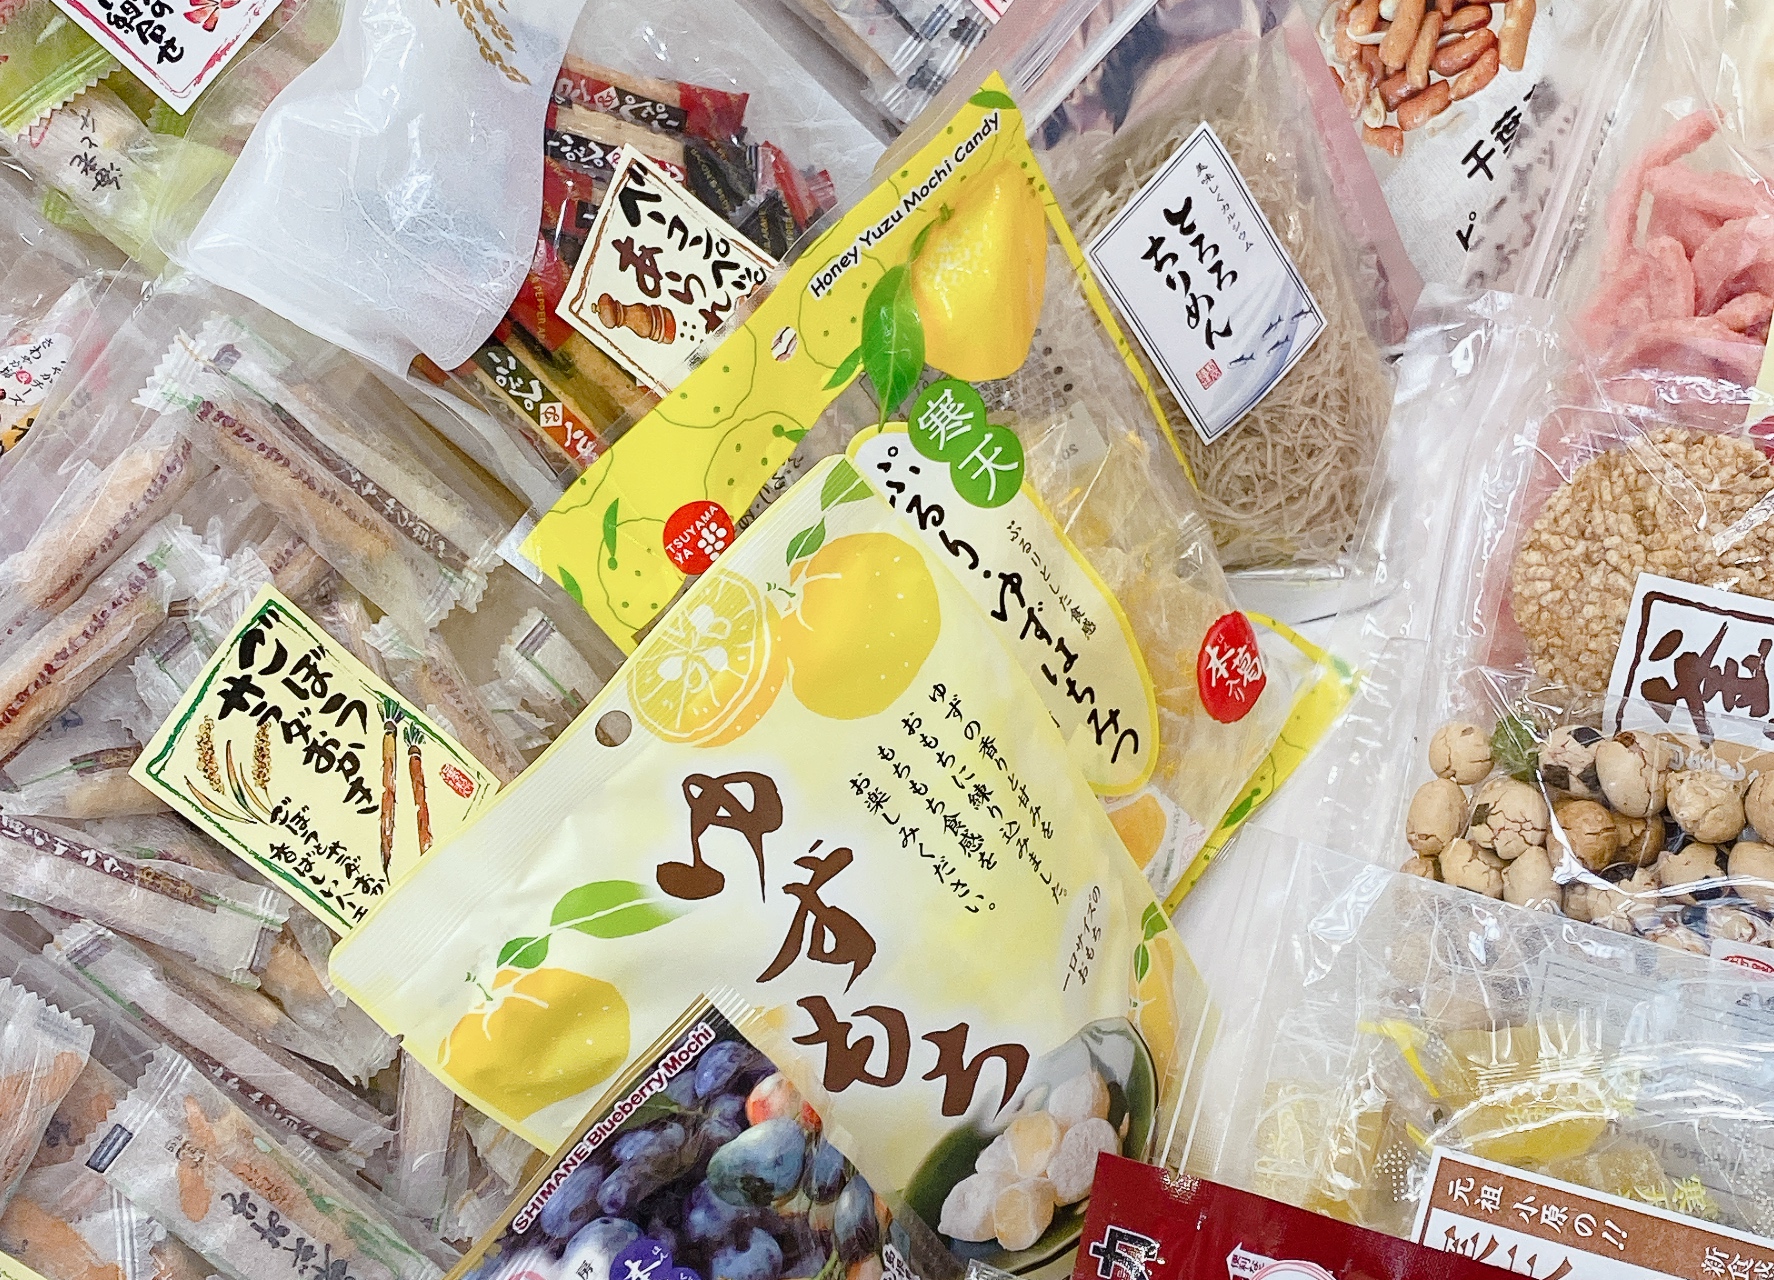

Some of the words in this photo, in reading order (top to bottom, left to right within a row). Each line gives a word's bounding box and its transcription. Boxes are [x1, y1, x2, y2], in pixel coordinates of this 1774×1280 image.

[811, 246, 861, 298] Honey
[860, 213, 903, 253] Yuzu
[904, 164, 951, 211] Mochi
[953, 112, 1003, 164] Candy
[1164, 196, 1238, 290] とろろ
[1195, 162, 1254, 253] 美味しくカルシウム
[612, 235, 732, 335] あられ
[1141, 235, 1233, 351] ちりめん
[918, 388, 1019, 502] 寒天
[664, 502, 720, 555] TSUYAMA
[674, 546, 695, 567] YA
[238, 608, 370, 736] ごぼう
[217, 673, 380, 815] サラダおかき
[928, 682, 1054, 840] ゆずの香りと甘みを
[848, 772, 996, 915] お楽しみください。
[876, 744, 998, 871] もちもち食感を
[900, 712, 1068, 906] おもちに練り込みました。
[655, 770, 1031, 1119] ゆずもち
[1077, 925, 1103, 986] おもち
[513, 1141, 588, 1234] SHIMANE
[588, 1067, 668, 1145] Blueberry
[663, 1022, 717, 1079] Mochi
[1448, 1176, 1506, 1214] 元祖
